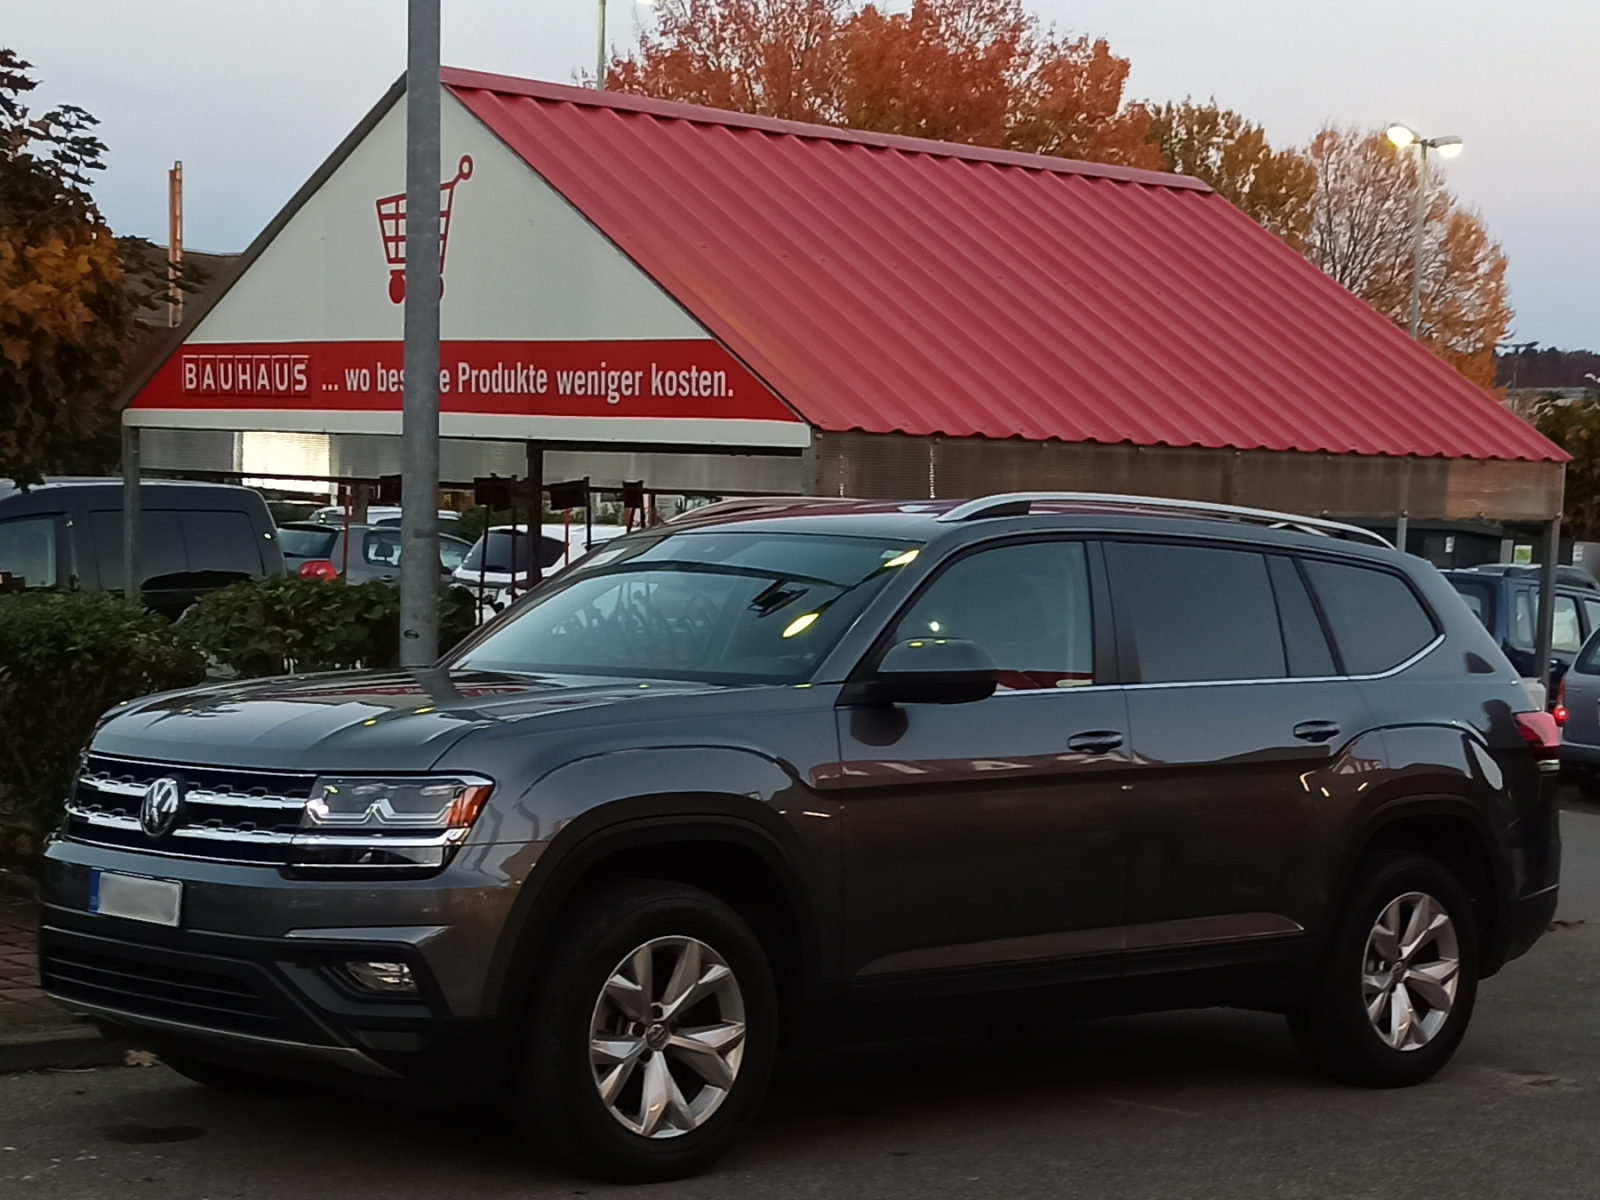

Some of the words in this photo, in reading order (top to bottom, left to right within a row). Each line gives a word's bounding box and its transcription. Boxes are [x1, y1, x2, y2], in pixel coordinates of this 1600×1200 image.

[185, 361, 307, 391] BAUHAUS
[344, 368, 370, 392] wo
[458, 361, 548, 394] Produkte
[556, 361, 644, 404] weniger
[651, 362, 734, 397] kosten.
